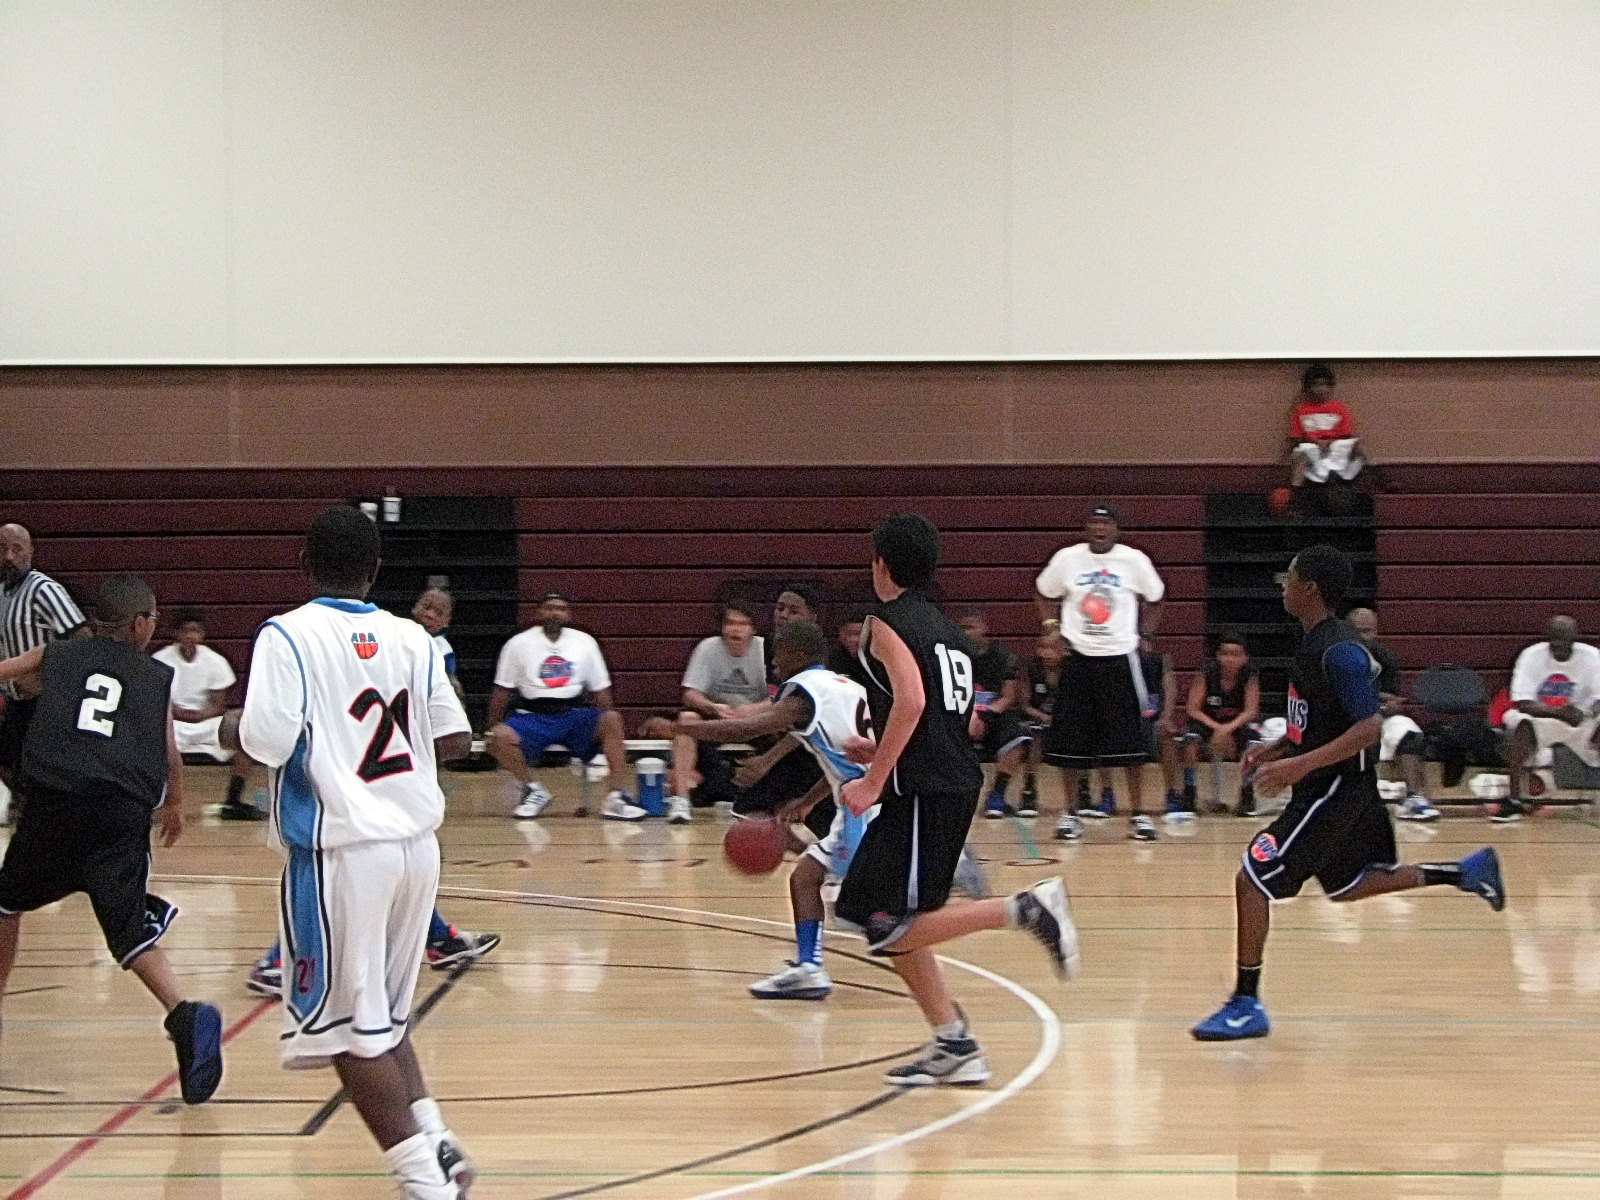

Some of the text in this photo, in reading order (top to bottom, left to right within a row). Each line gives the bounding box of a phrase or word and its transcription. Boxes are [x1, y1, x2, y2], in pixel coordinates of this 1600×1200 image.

[77, 672, 123, 738] 2
[934, 643, 974, 715] 19
[296, 957, 317, 995] 21
